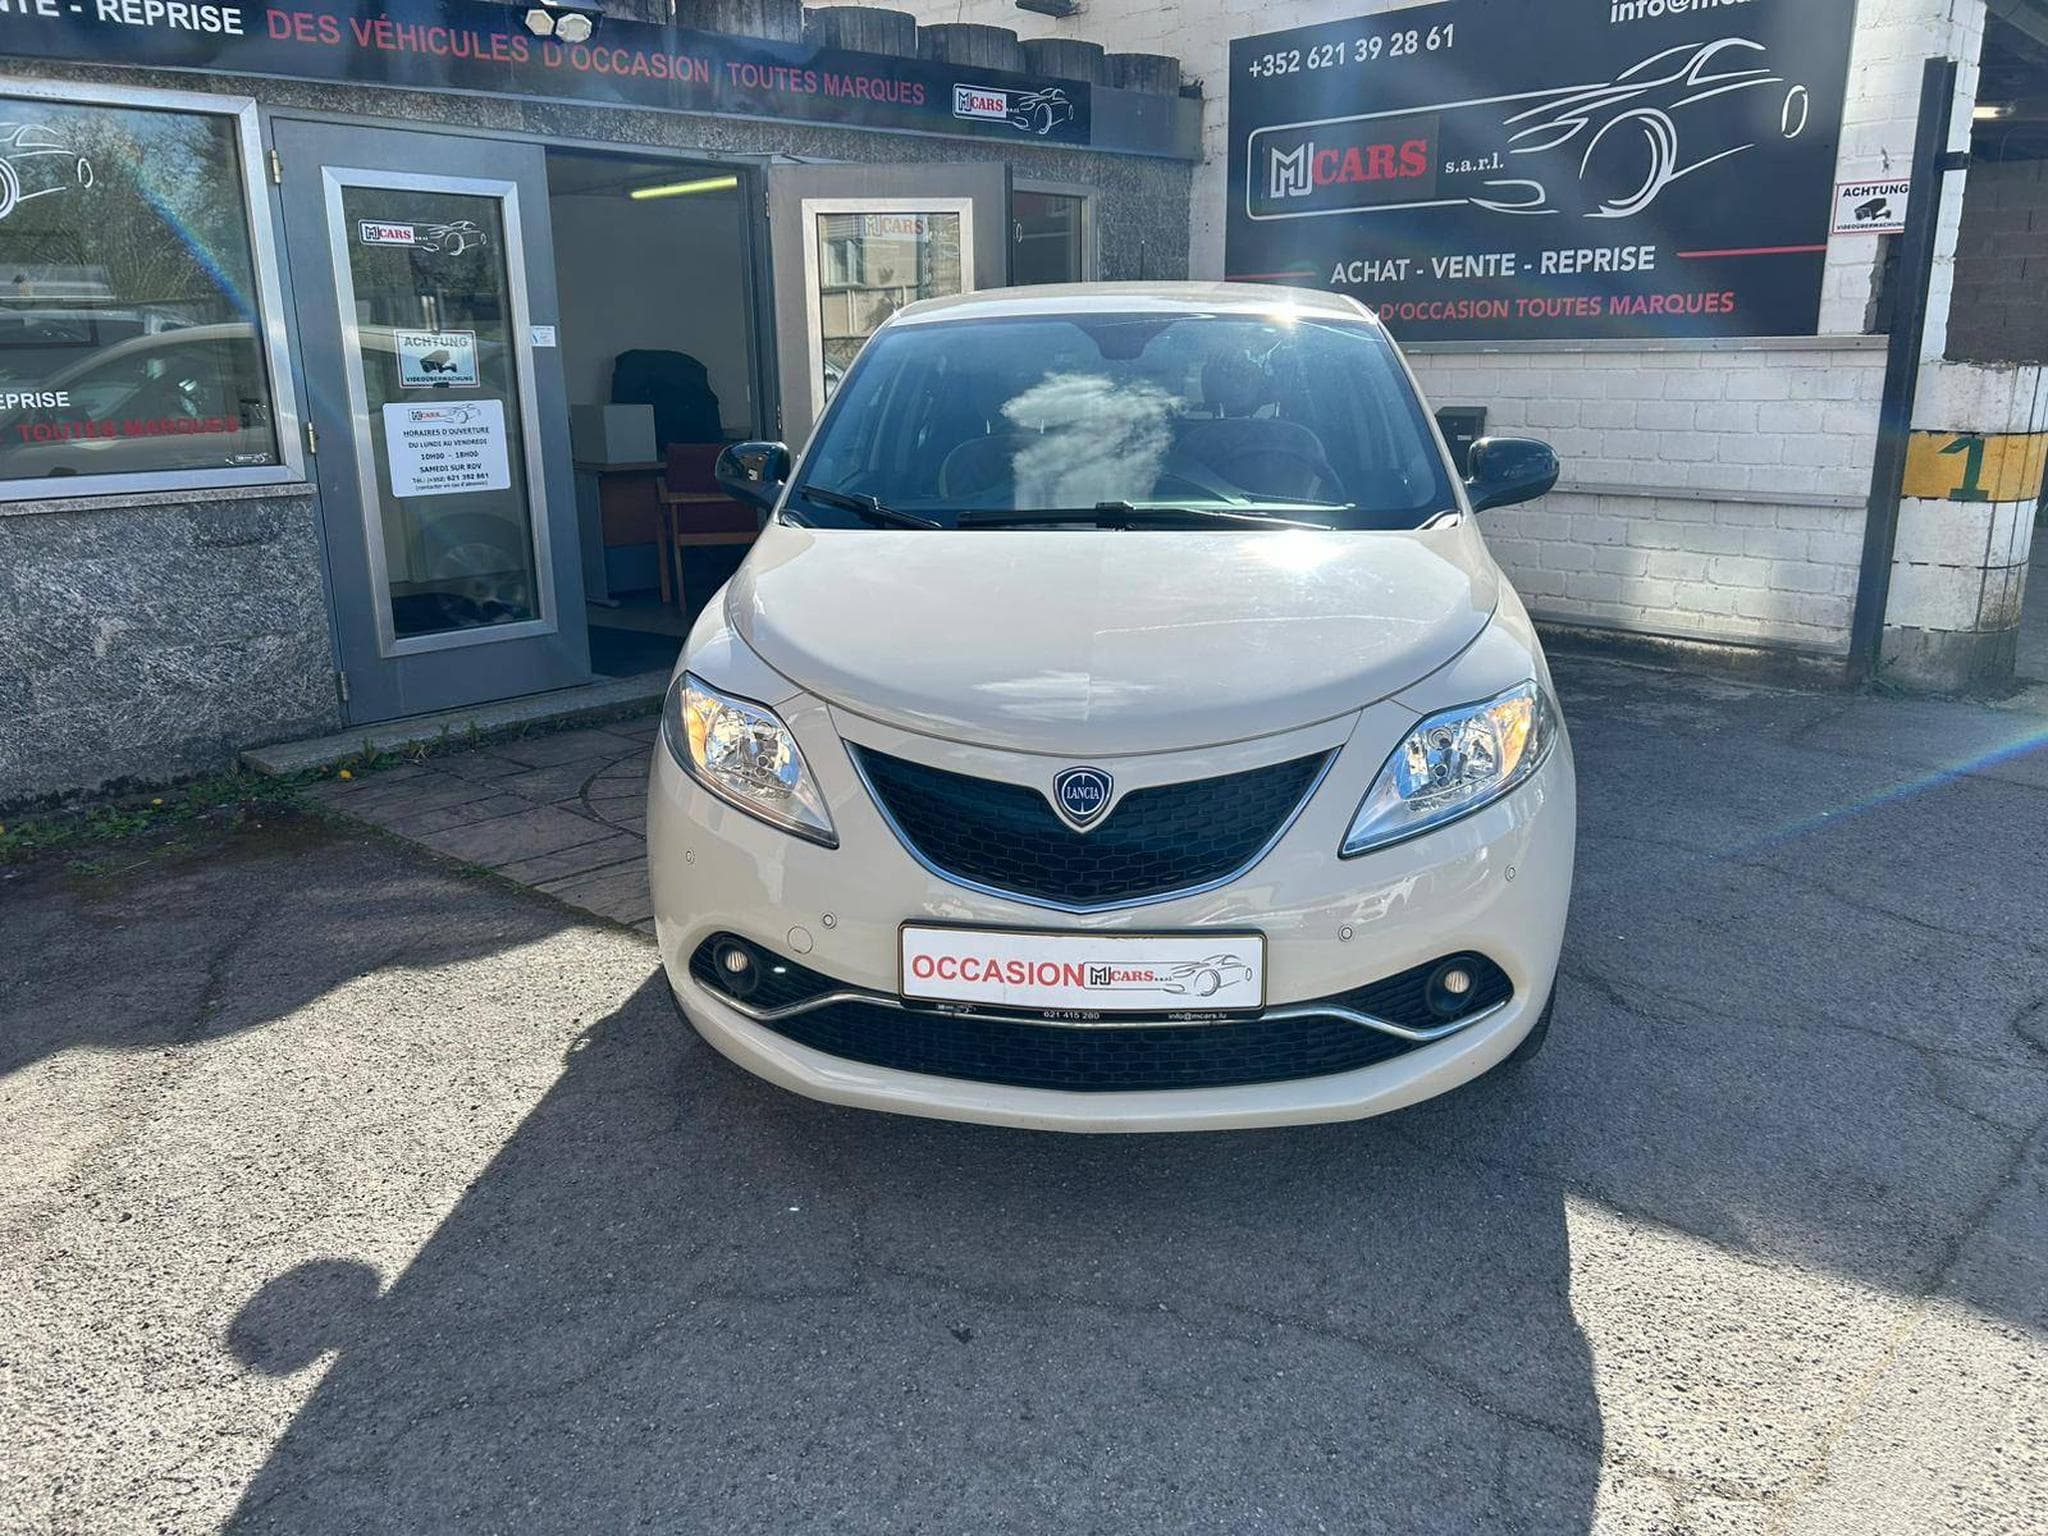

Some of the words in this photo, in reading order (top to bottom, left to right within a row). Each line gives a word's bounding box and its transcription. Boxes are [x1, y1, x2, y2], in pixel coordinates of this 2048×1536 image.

[97, 0, 245, 35] REPRISE
[266, 9, 341, 45] DES
[349, 12, 529, 63] VÉHICULES
[542, 40, 709, 84] D'OCCASION
[726, 61, 817, 94] TOUTES
[823, 72, 925, 106] MARQUES
[1249, 49, 1301, 78] +352
[1306, 41, 1346, 70] 621
[1354, 35, 1383, 62] 39
[1389, 30, 1418, 57] 28
[1426, 23, 1454, 51] 61
[1445, 152, 1504, 174] s.a.r.l.
[1842, 183, 1909, 197] ACHTUNG
[1330, 258, 1410, 284] ACHAT
[1431, 253, 1516, 280] VENTE
[1540, 245, 1656, 275] REPRISE
[1380, 298, 1510, 320] D'OCCASION
[1516, 296, 1602, 318] TOUTES
[1608, 291, 1735, 316] MARQUES
[404, 335, 469, 347] ACHTUNG
[1937, 436, 1989, 501] 1
[1067, 786, 1099, 800] LANCIA
[912, 953, 1085, 988] OCCASION
